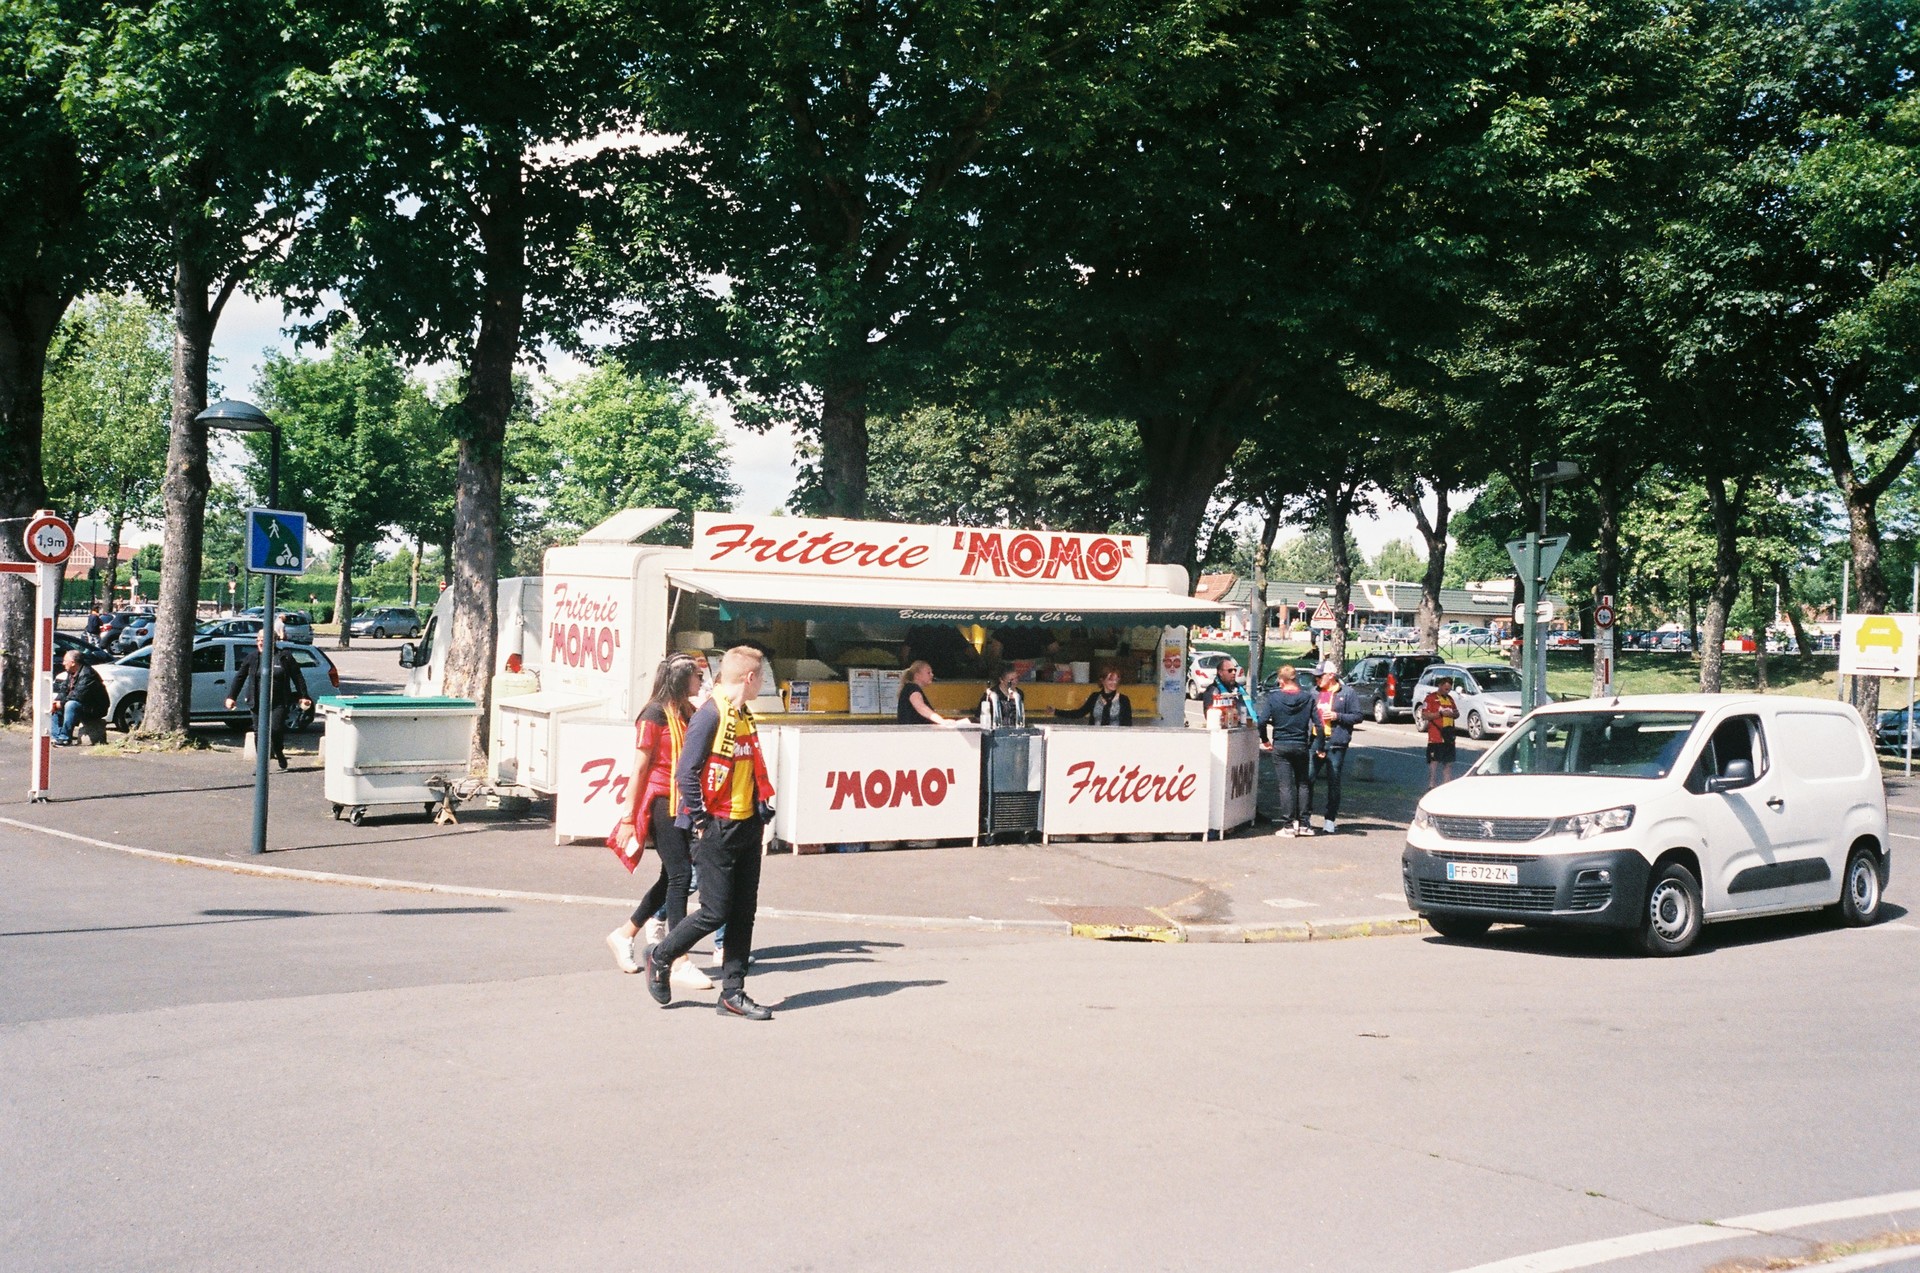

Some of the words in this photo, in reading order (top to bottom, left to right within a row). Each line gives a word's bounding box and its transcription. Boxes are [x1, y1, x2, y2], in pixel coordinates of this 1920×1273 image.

[37, 534, 65, 548] 1,9m
[705, 523, 929, 568] Friterie
[953, 530, 1133, 582] 'MOMO'
[554, 583, 618, 622] Friterie
[899, 609, 975, 621] Bienvenue
[979, 612, 1009, 623] chez
[1014, 612, 1035, 622] les
[1039, 612, 1083, 623] Ch'tis
[549, 621, 620, 673] 'MOMO'
[720, 721, 736, 756] FIER
[580, 757, 630, 805] Fr
[826, 767, 956, 811] 'MOMO'
[1066, 760, 1197, 804] Friterie
[1454, 865, 1509, 880] FF-672-ZK
